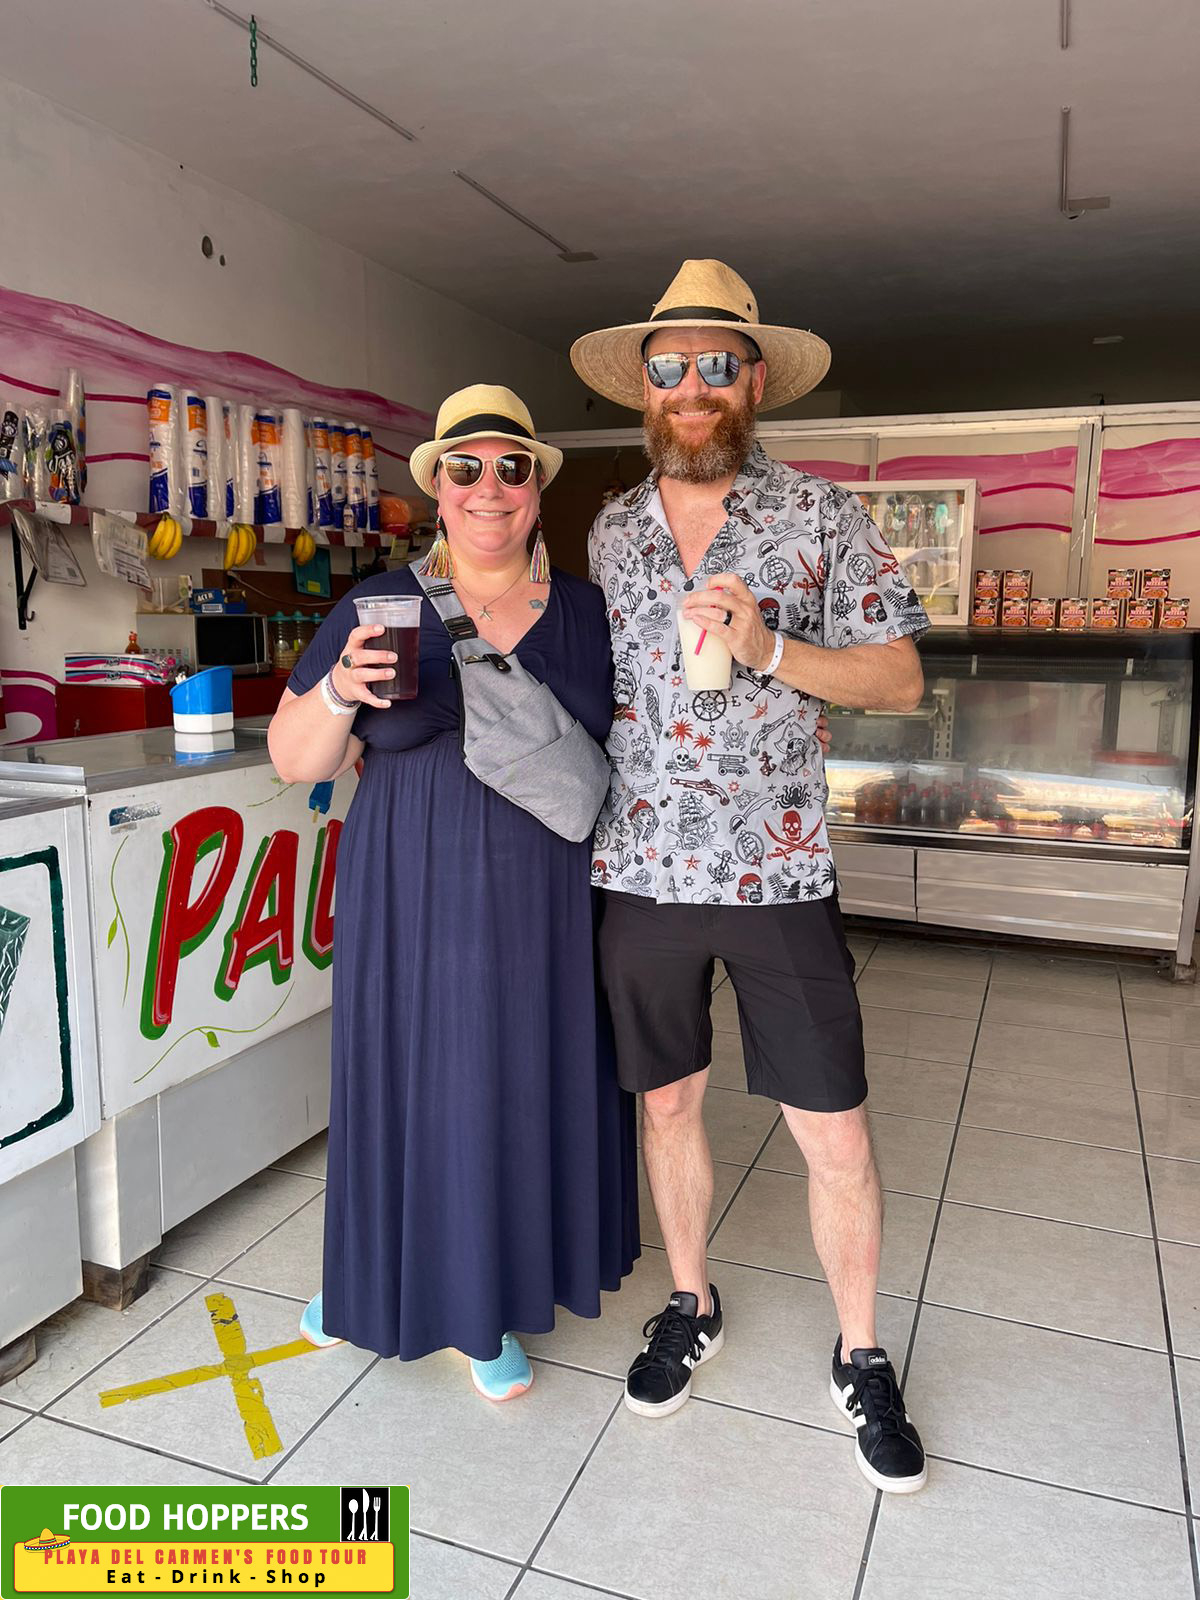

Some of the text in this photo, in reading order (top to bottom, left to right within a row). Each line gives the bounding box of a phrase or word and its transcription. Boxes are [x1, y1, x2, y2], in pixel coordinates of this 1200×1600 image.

[678, 695, 741, 714] W E
[708, 725, 716, 736] S
